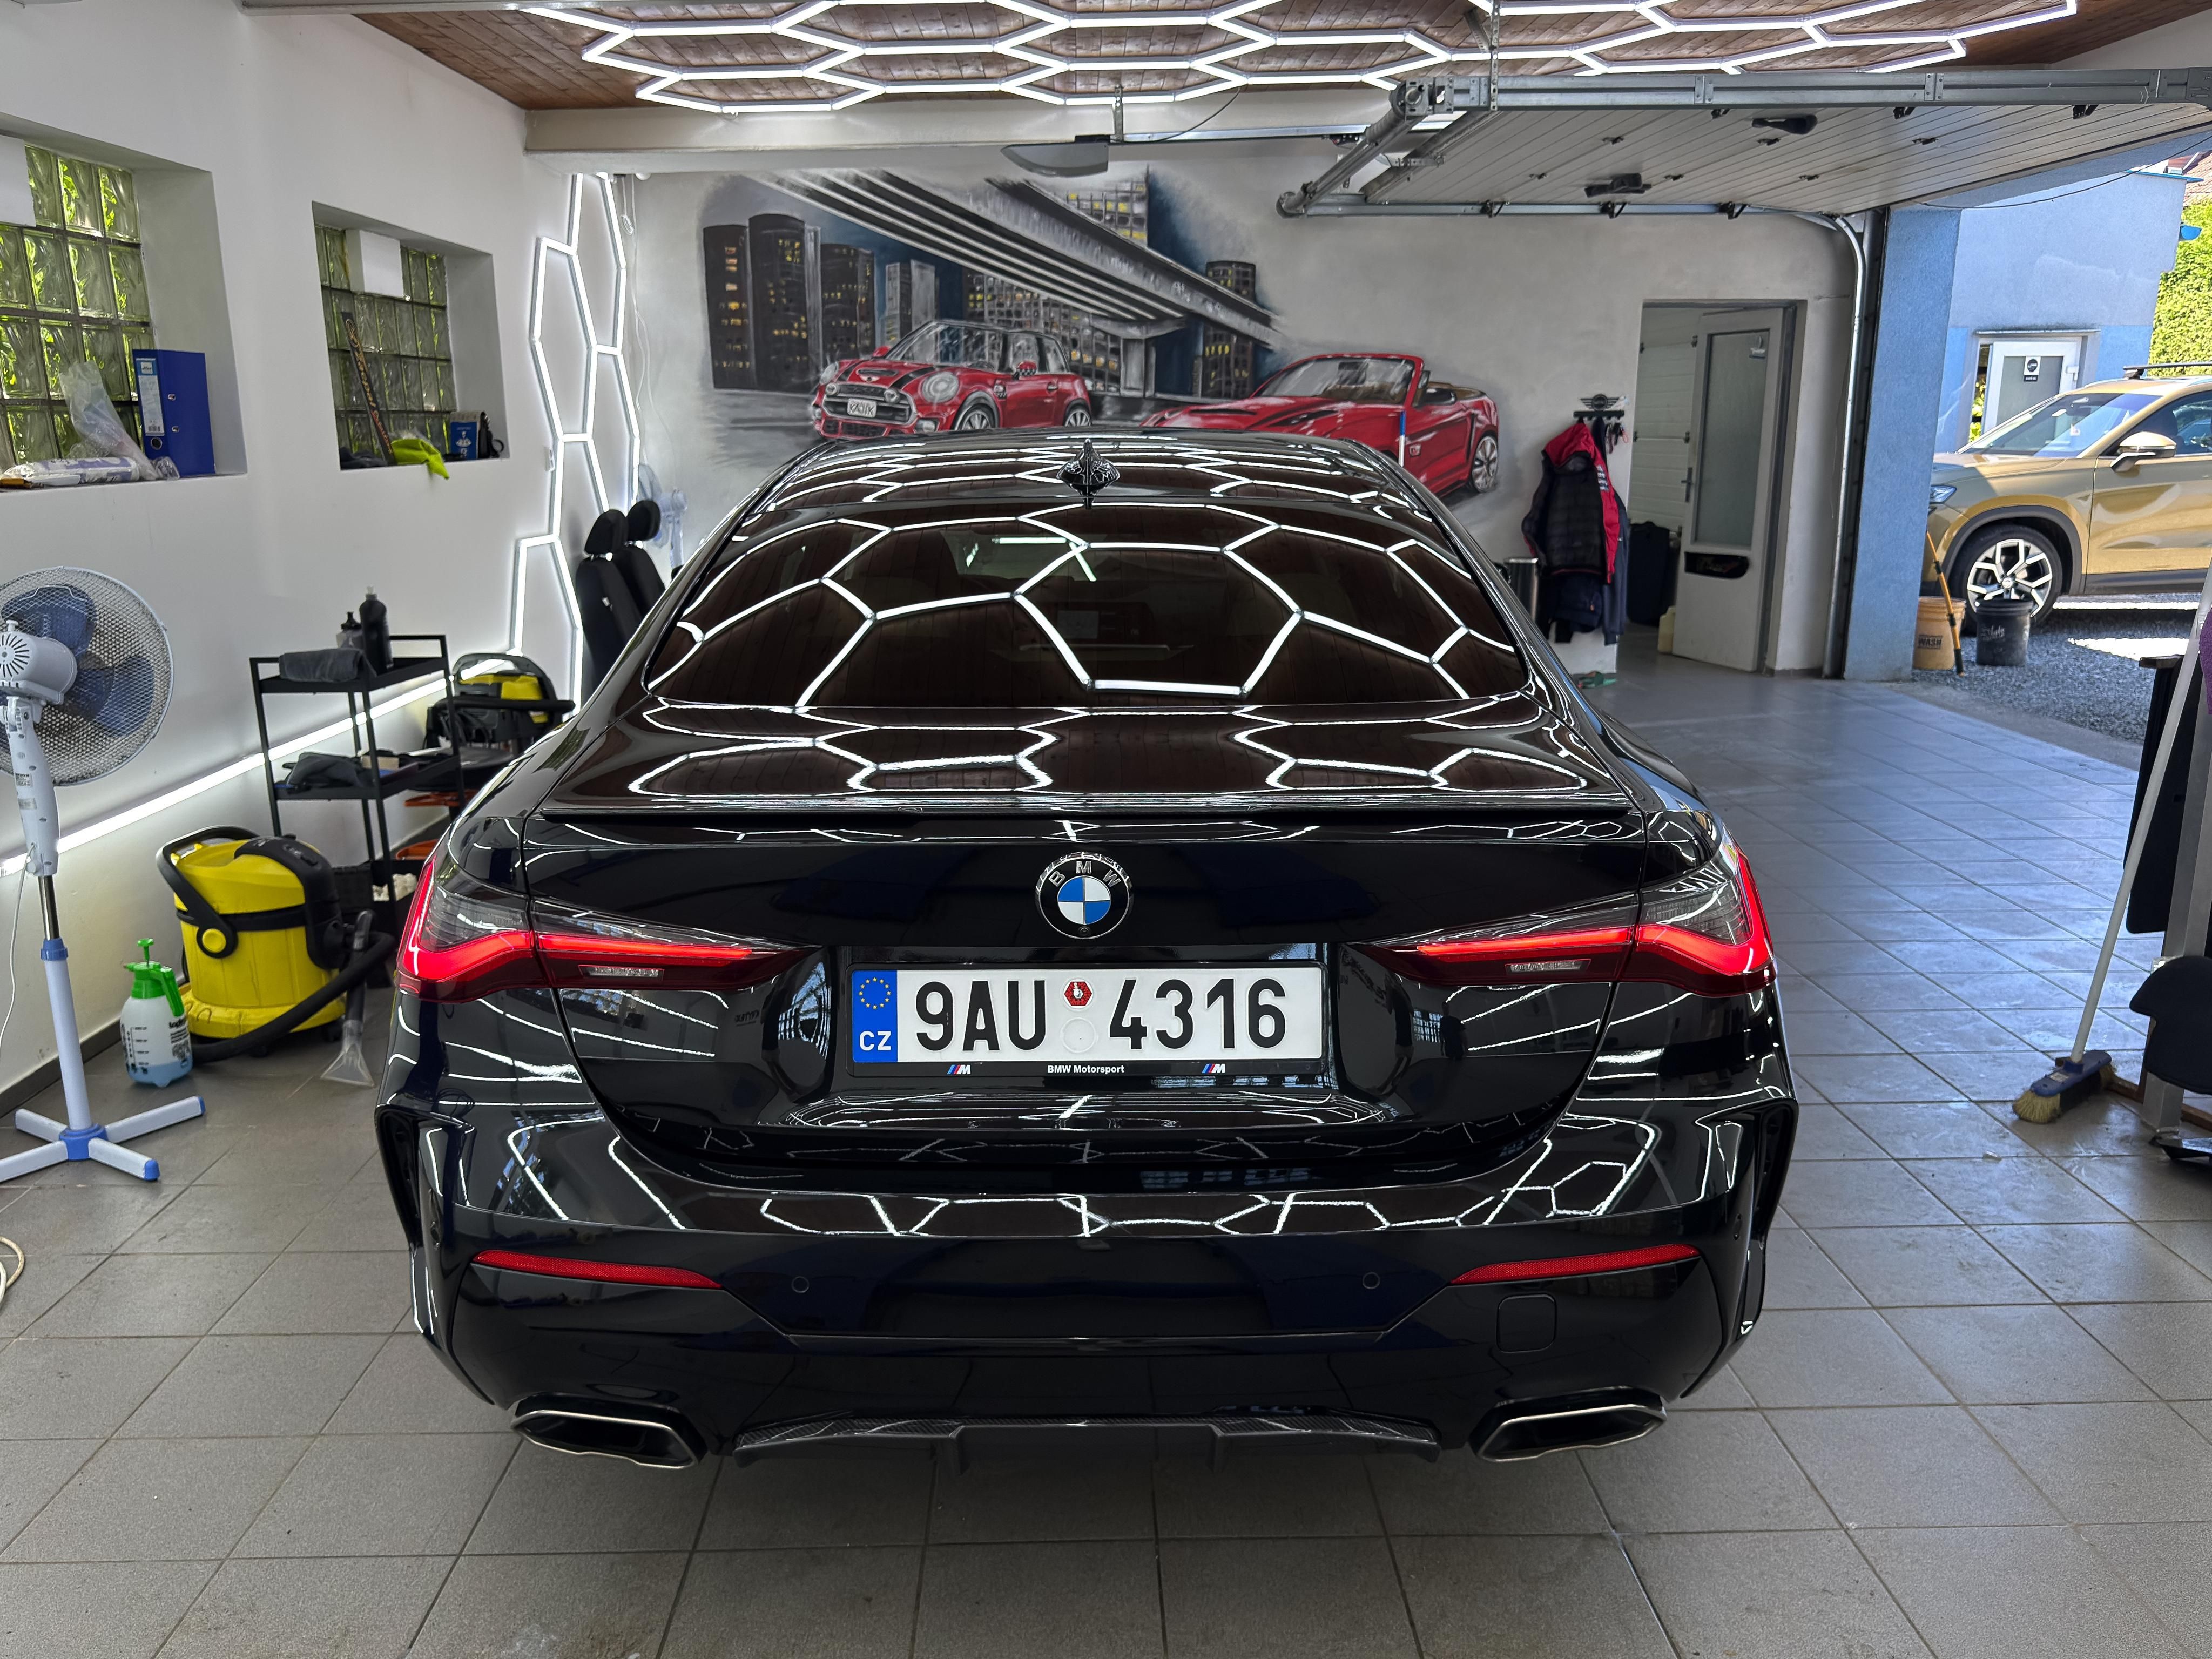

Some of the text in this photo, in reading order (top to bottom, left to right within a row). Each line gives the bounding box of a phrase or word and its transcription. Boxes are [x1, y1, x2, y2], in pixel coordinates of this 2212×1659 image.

[1918, 637, 1942, 646] WASH
[1048, 860, 1121, 887] BMW
[916, 978, 1286, 1051] 9AU 4316
[859, 1030, 892, 1051] CZ
[1047, 1065, 1125, 1075] BMW Motorsport
